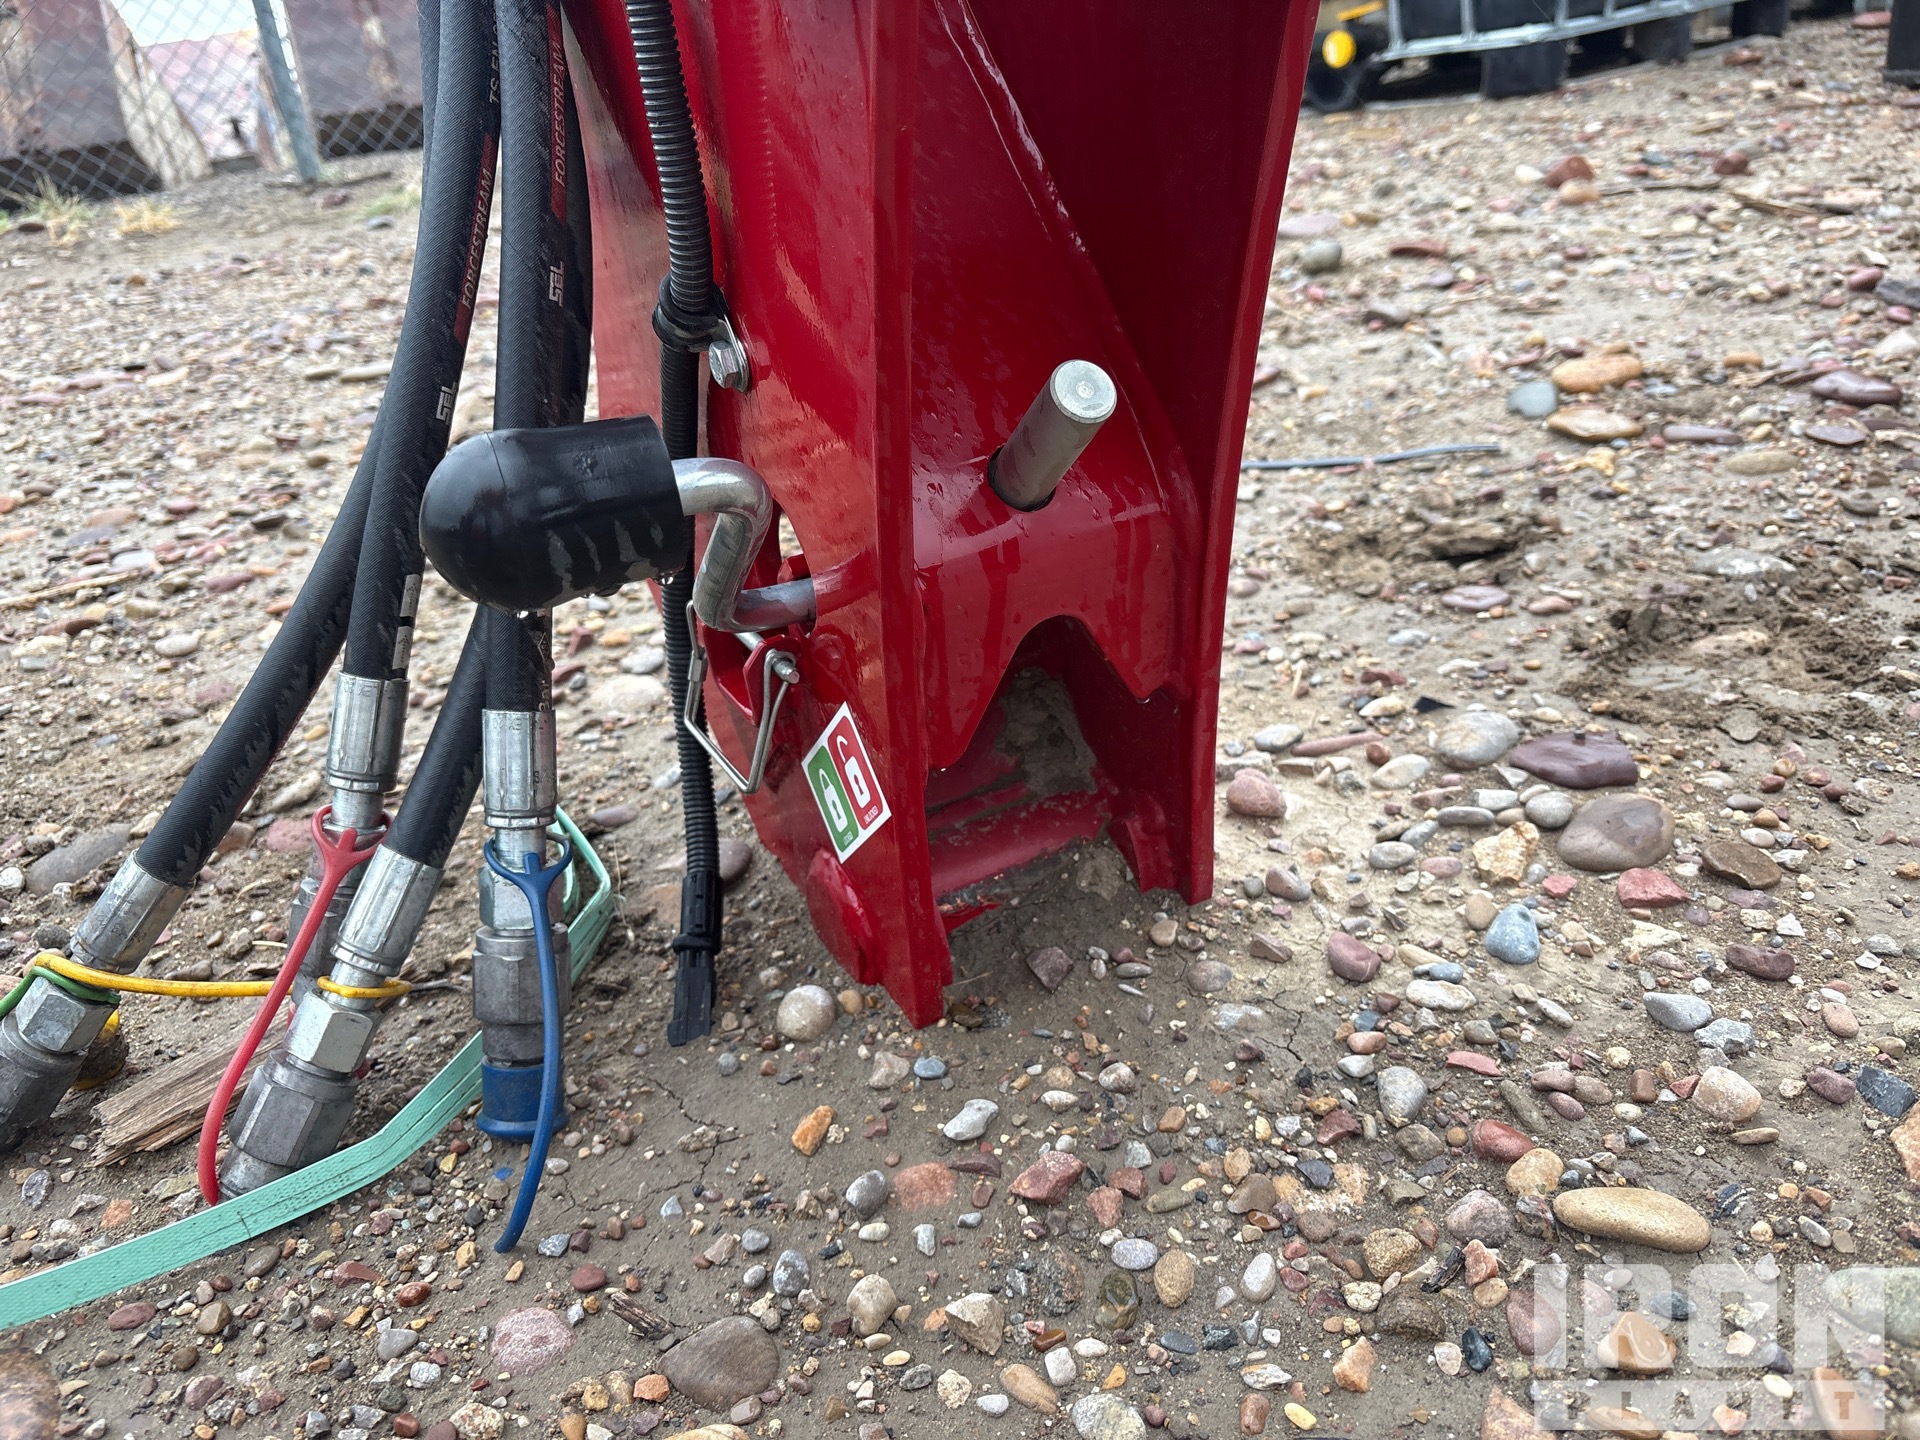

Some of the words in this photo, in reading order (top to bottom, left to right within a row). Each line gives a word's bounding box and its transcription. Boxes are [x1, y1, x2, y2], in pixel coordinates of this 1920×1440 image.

[552, 41, 566, 187] FORCESTREAM
[462, 168, 493, 310] FORCESTREAM
[548, 260, 565, 308] SEL
[436, 381, 458, 426] SEL
